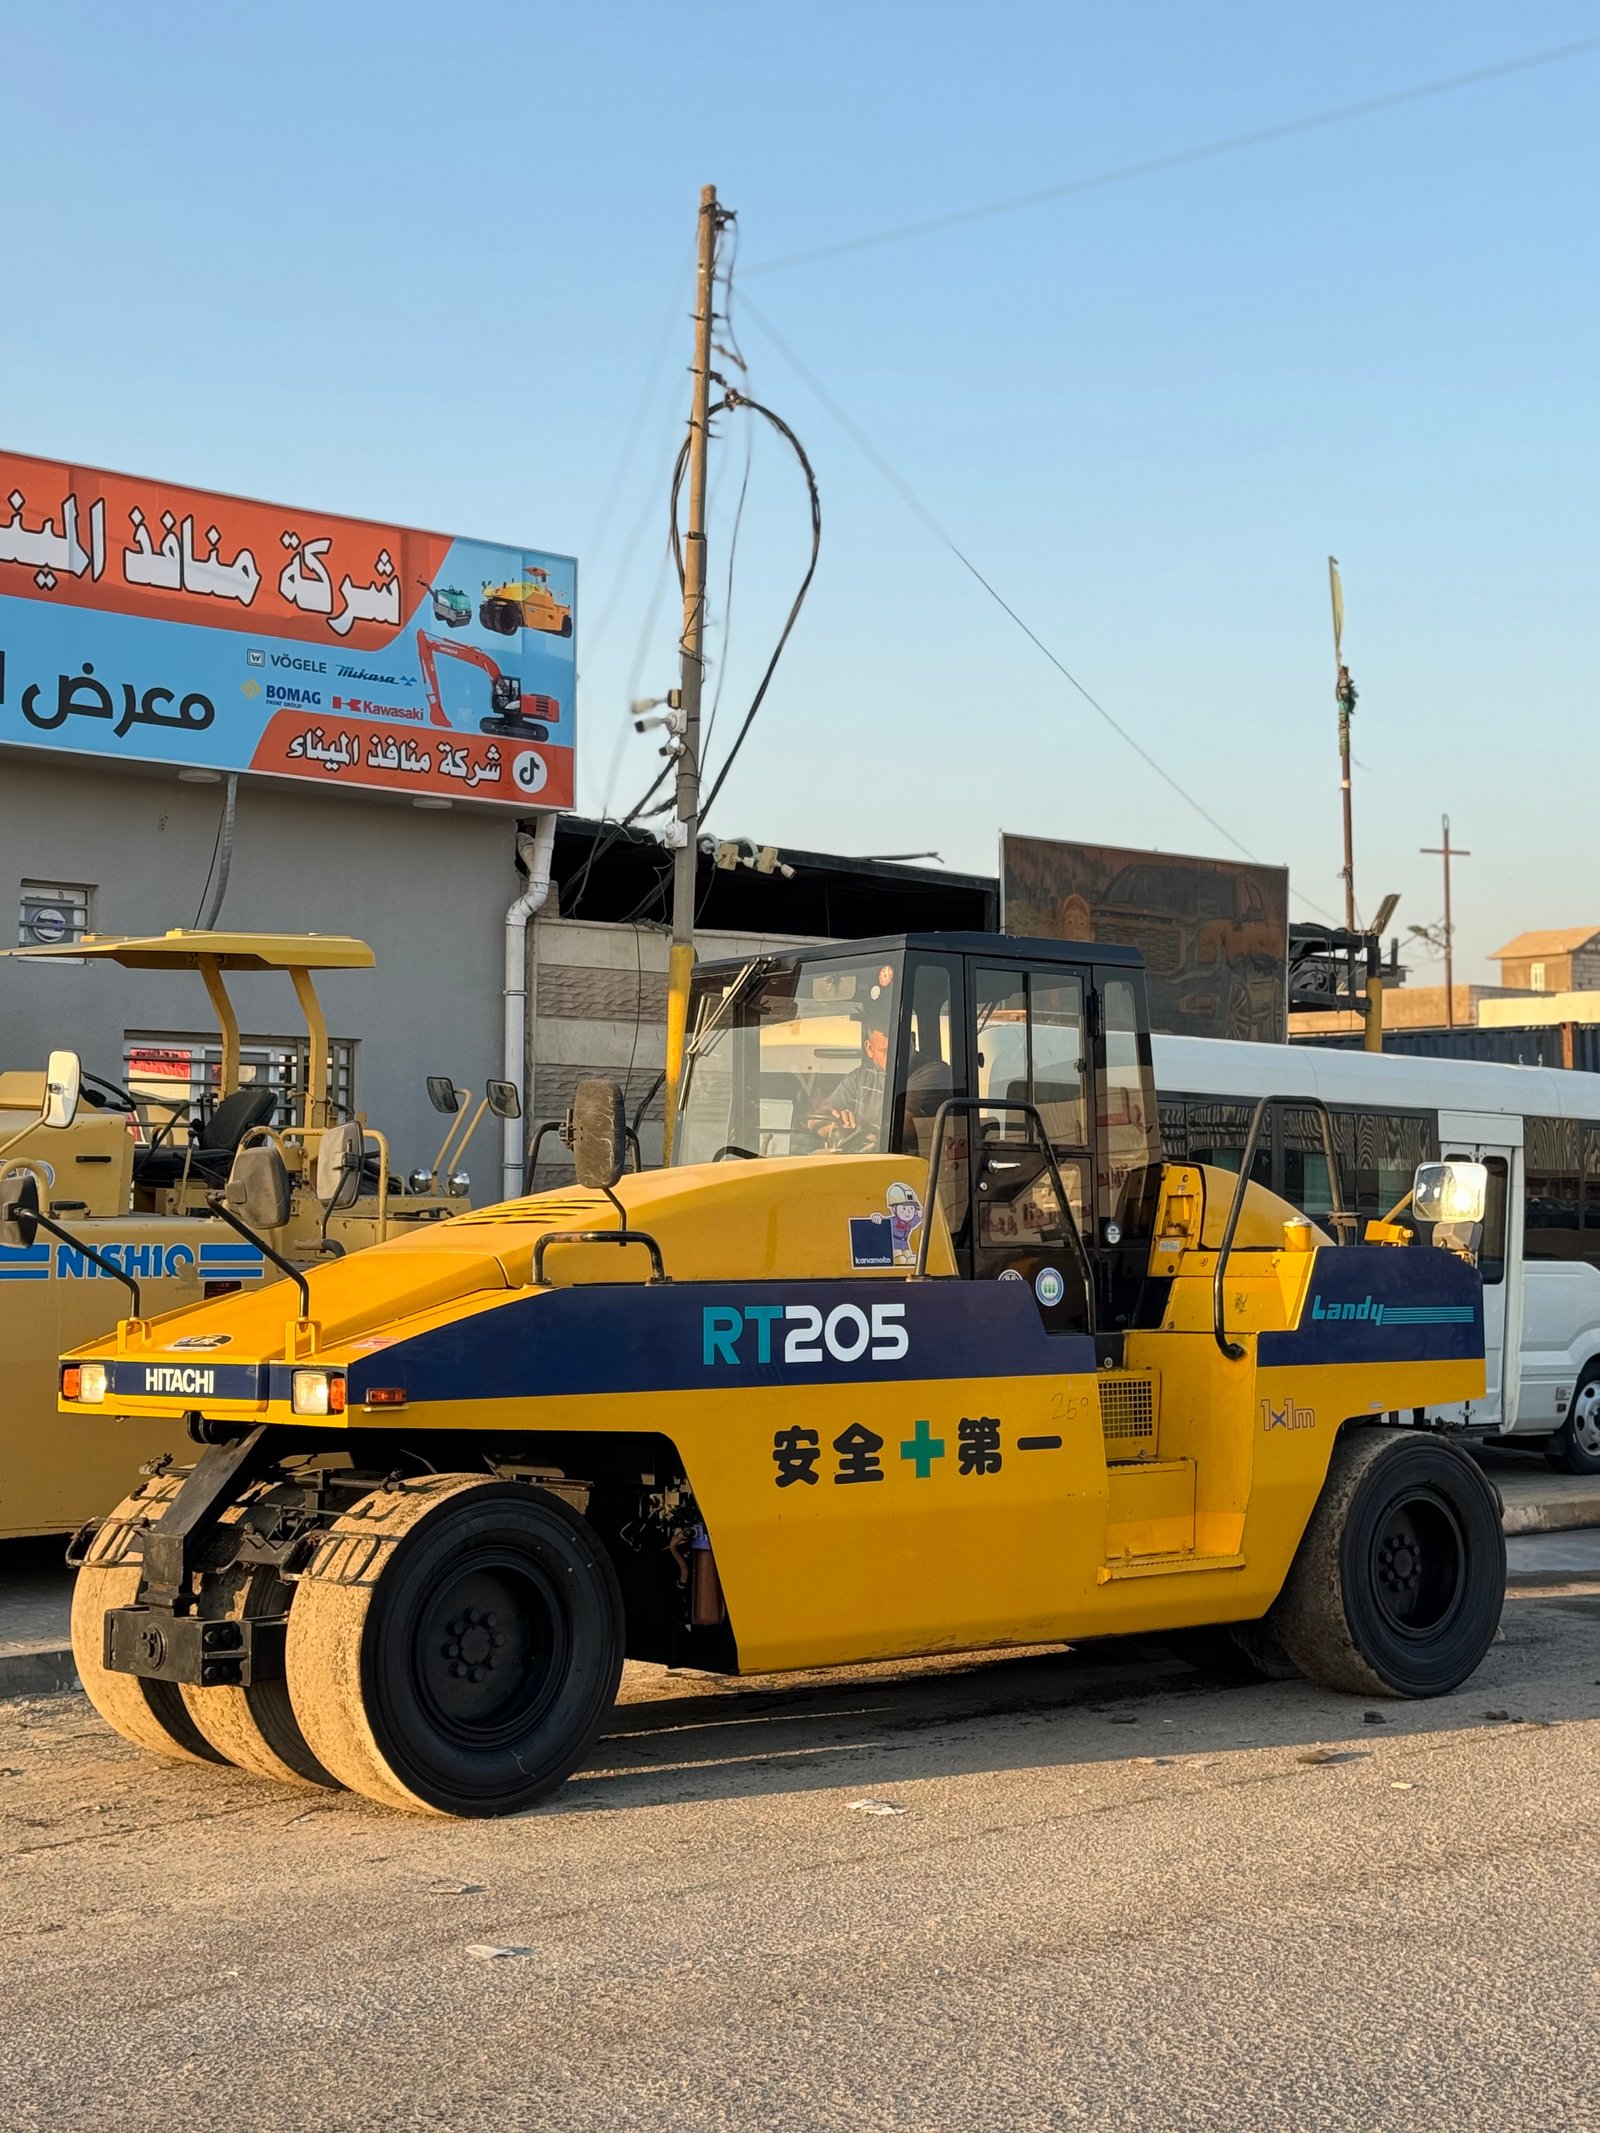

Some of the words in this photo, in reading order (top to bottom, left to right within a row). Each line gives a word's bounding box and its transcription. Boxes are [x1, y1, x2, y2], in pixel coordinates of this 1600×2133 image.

[122, 505, 262, 607] منافذ
[278, 530, 401, 637] شركة
[270, 653, 327, 674] VÖGELE
[335, 664, 399, 685] Mikasa
[21, 662, 215, 738] معرض
[266, 684, 321, 705] BOMAG
[363, 701, 424, 721] Kawasaki
[286, 726, 360, 772] الميناء
[367, 734, 432, 773] منافذ
[436, 744, 501, 787] شركة
[56, 1244, 195, 1279] NISHIO
[855, 1256, 892, 1264] kanamoto
[1312, 1295, 1385, 1326] Landy
[703, 1303, 909, 1365] RT205
[145, 1368, 214, 1394] HITACHI
